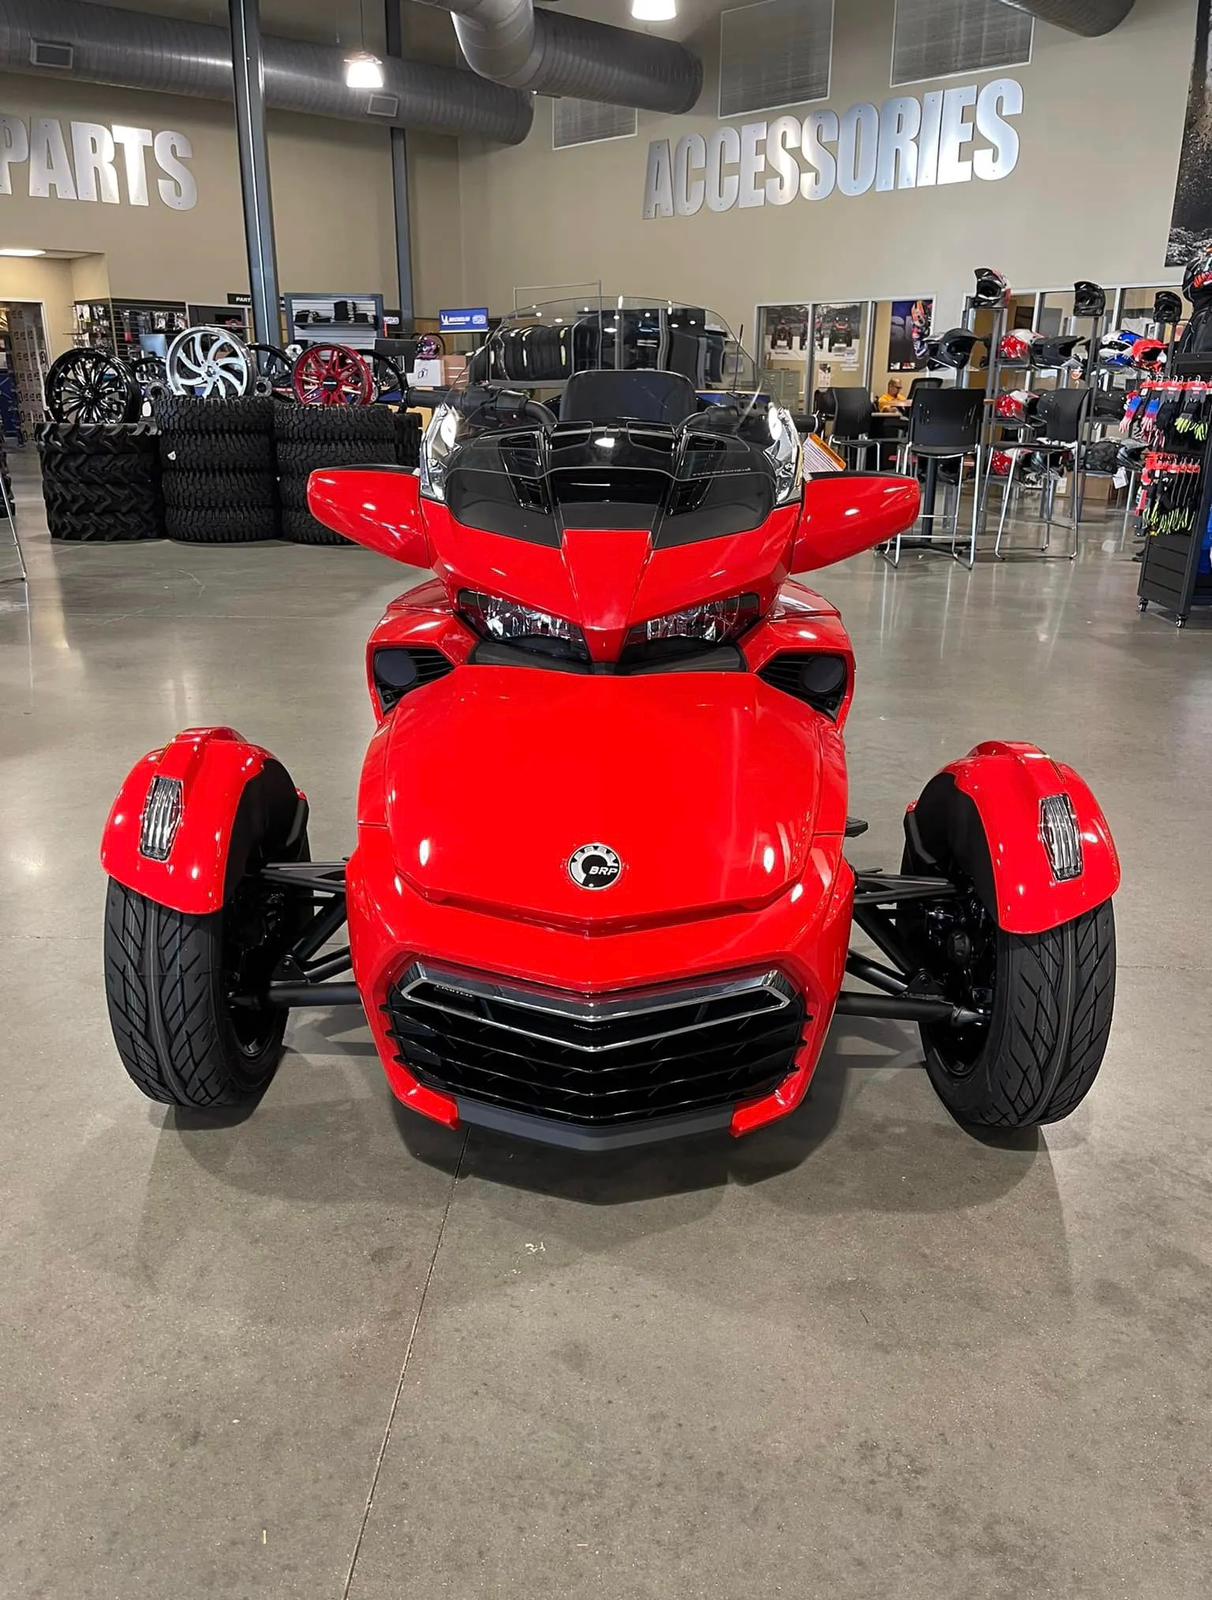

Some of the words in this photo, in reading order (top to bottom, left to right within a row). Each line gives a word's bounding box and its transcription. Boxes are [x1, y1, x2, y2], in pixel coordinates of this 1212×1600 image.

[0, 115, 197, 211] PARTS
[642, 78, 1023, 219] ACCESSORIES
[588, 865, 619, 876] BRP
